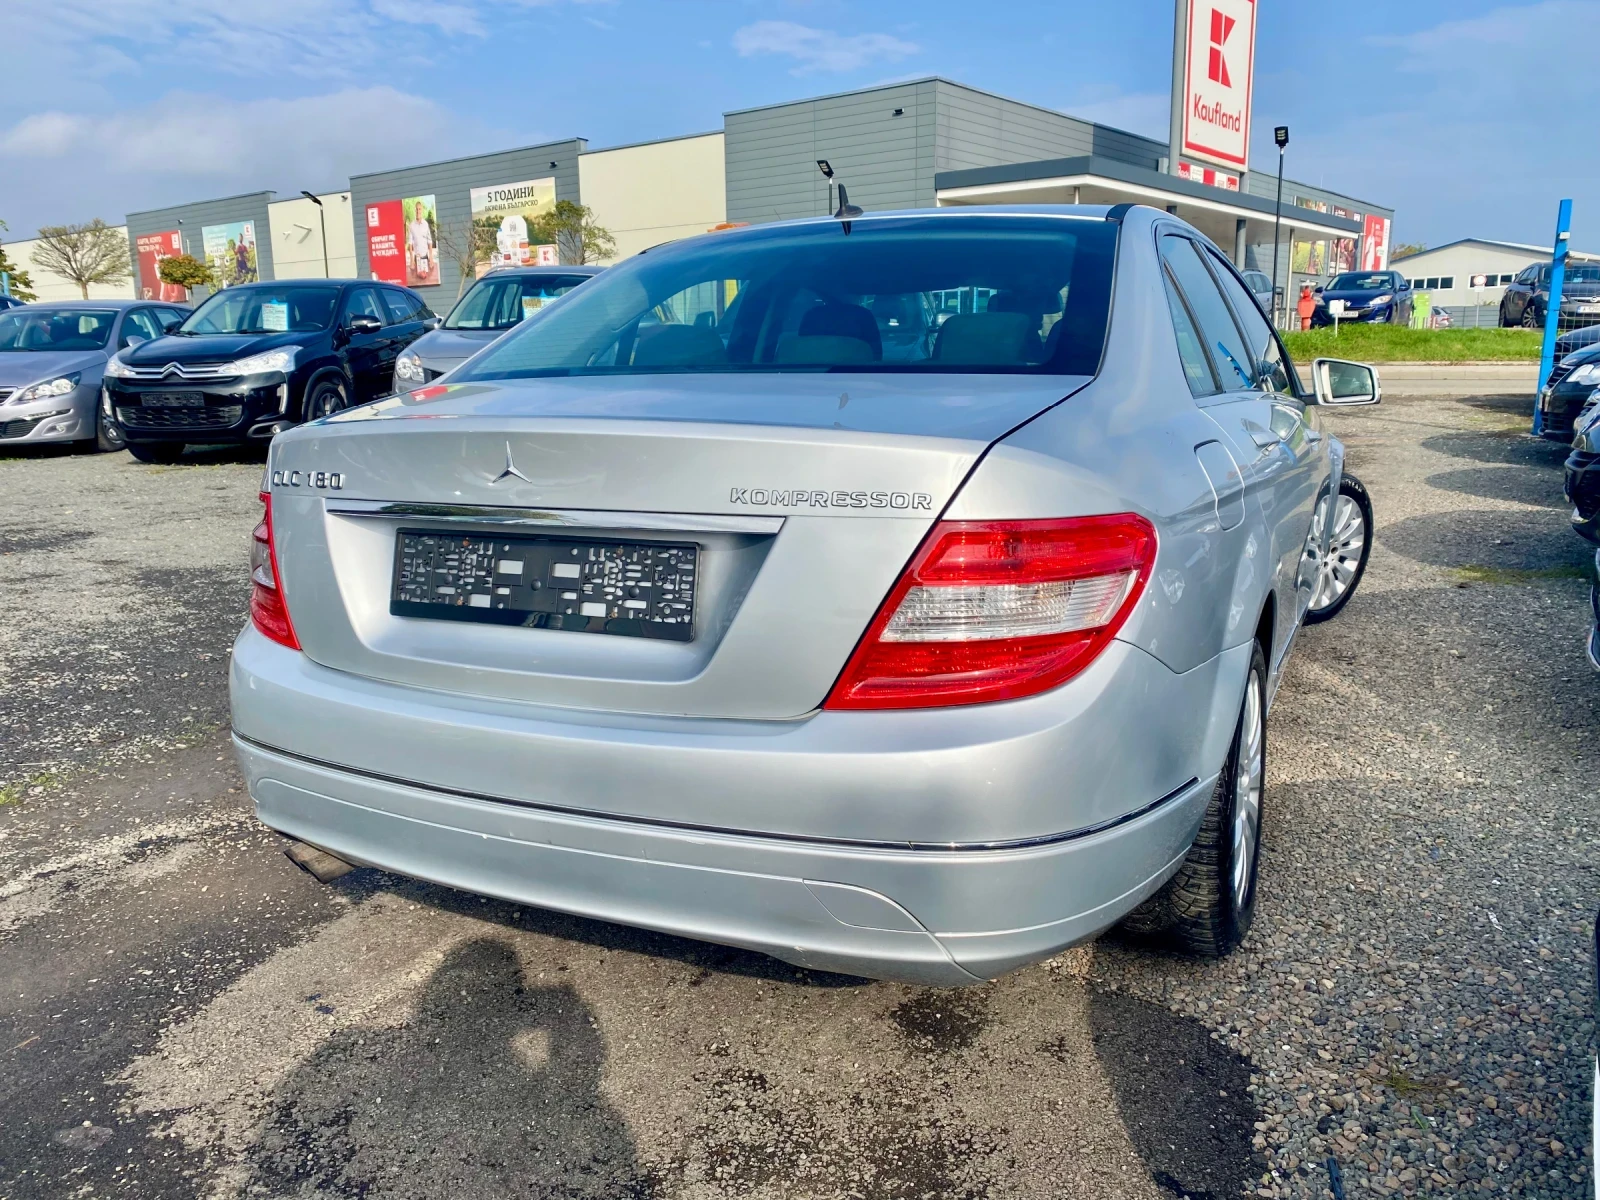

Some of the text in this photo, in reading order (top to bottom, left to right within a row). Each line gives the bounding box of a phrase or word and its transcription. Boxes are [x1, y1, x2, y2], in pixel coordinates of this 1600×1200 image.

[1193, 93, 1241, 133] Kaufland
[487, 186, 535, 203] 5 ГОДИНИ
[499, 203, 506, 211] НА
[507, 199, 539, 209] БЪЛГАРСКО
[273, 470, 346, 490] CLC 180
[730, 487, 932, 510] KOMPRESSOR
